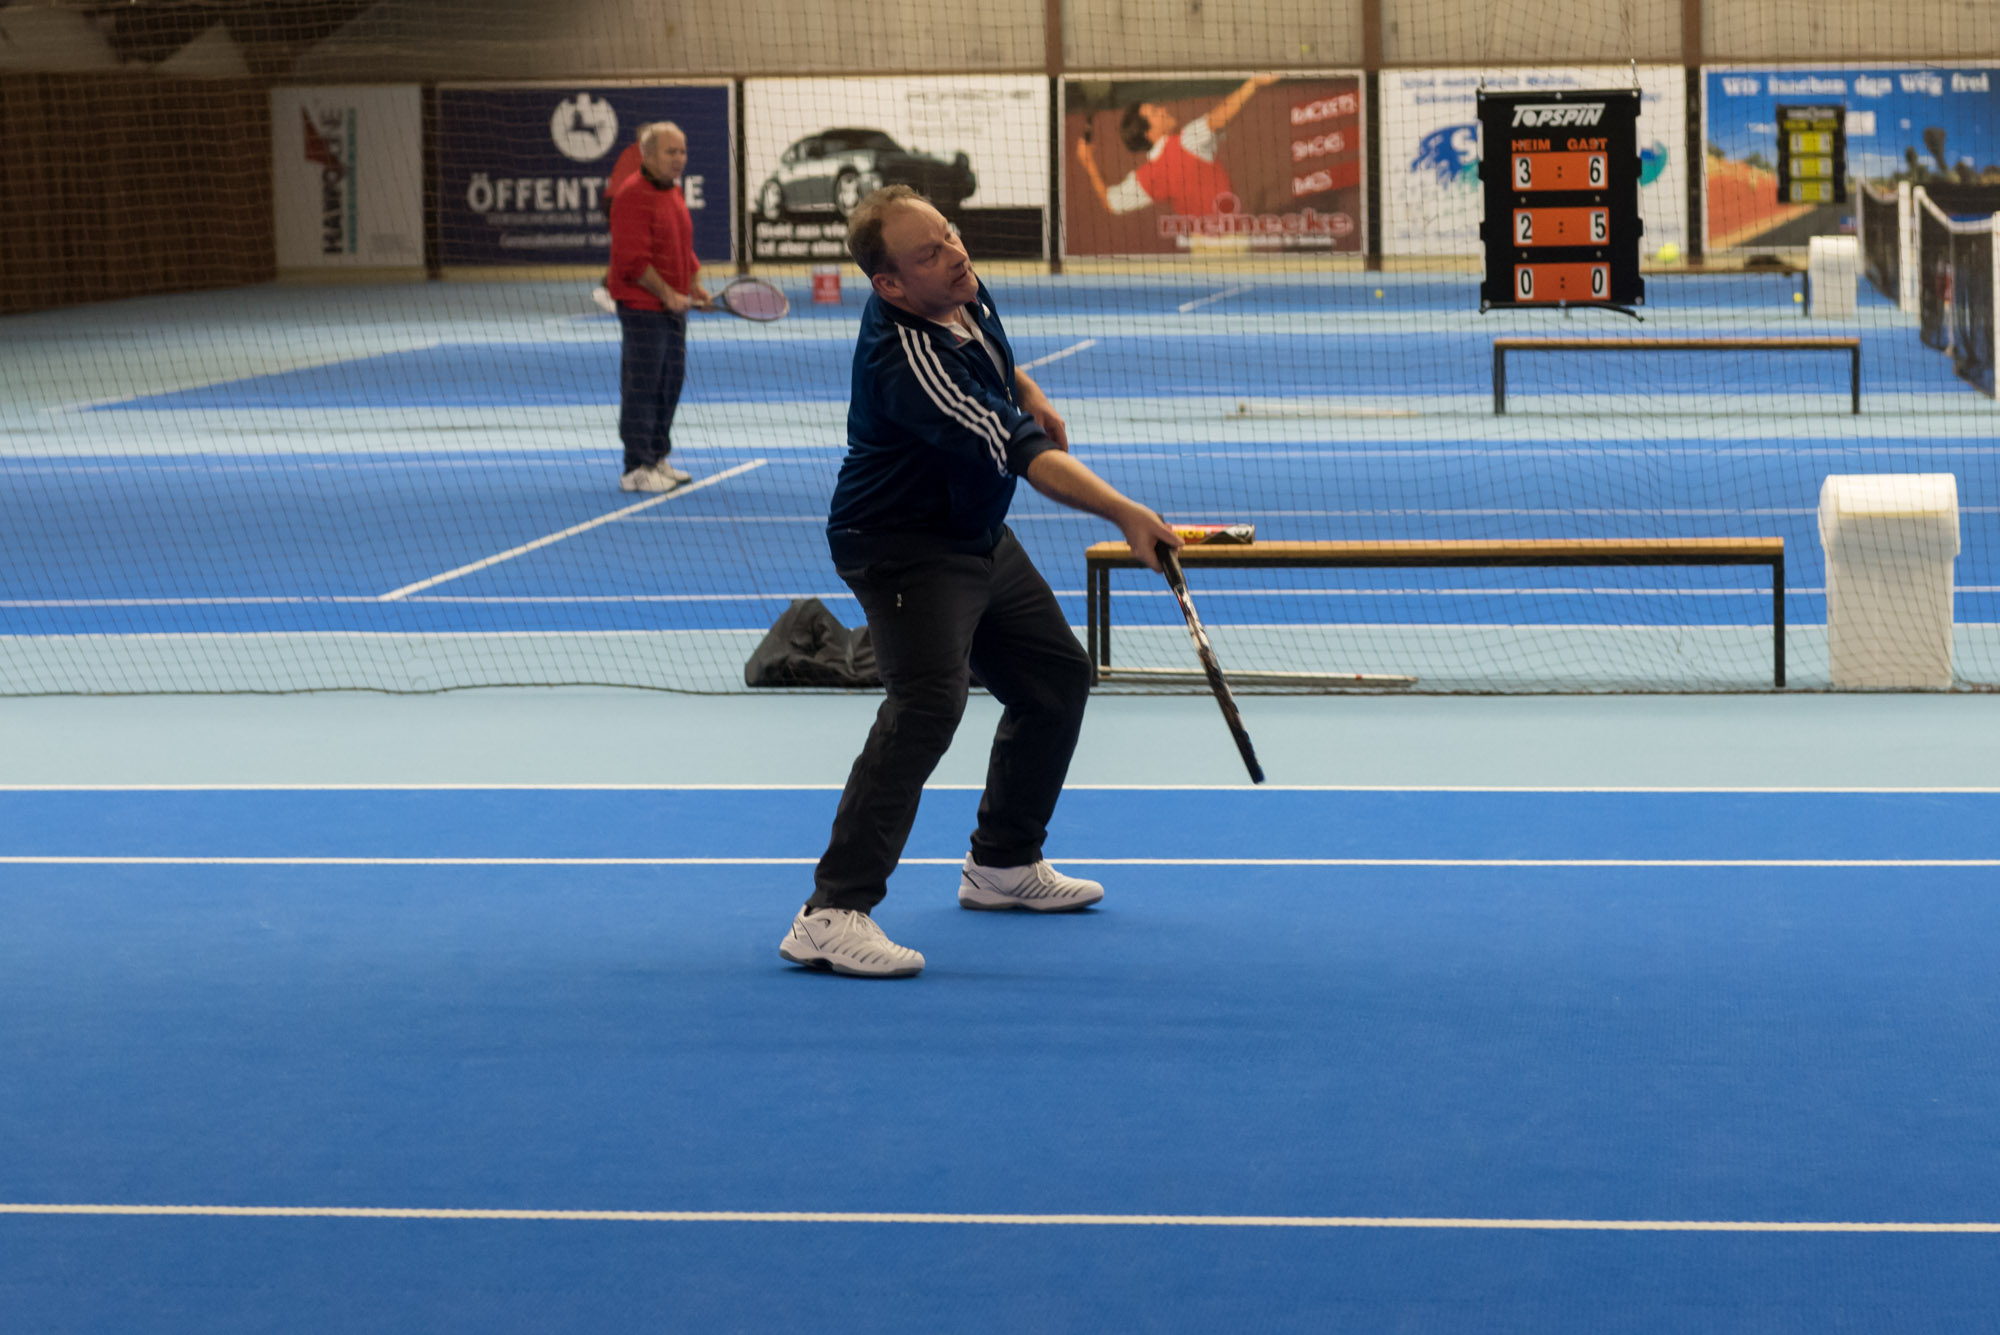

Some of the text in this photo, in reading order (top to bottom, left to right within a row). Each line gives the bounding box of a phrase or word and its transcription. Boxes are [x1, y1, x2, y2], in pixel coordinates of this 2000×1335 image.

[1512, 103, 1606, 127] TOPSPIN
[1512, 138, 1608, 152] HEIM GAST
[1519, 158, 1531, 184] 3
[1590, 158, 1601, 183] 6
[467, 172, 706, 213] ÖFFENTE
[1521, 215, 1532, 240] 2
[1595, 213, 1606, 239] 5
[1520, 269, 1532, 295] 0
[1592, 268, 1603, 294] 0
